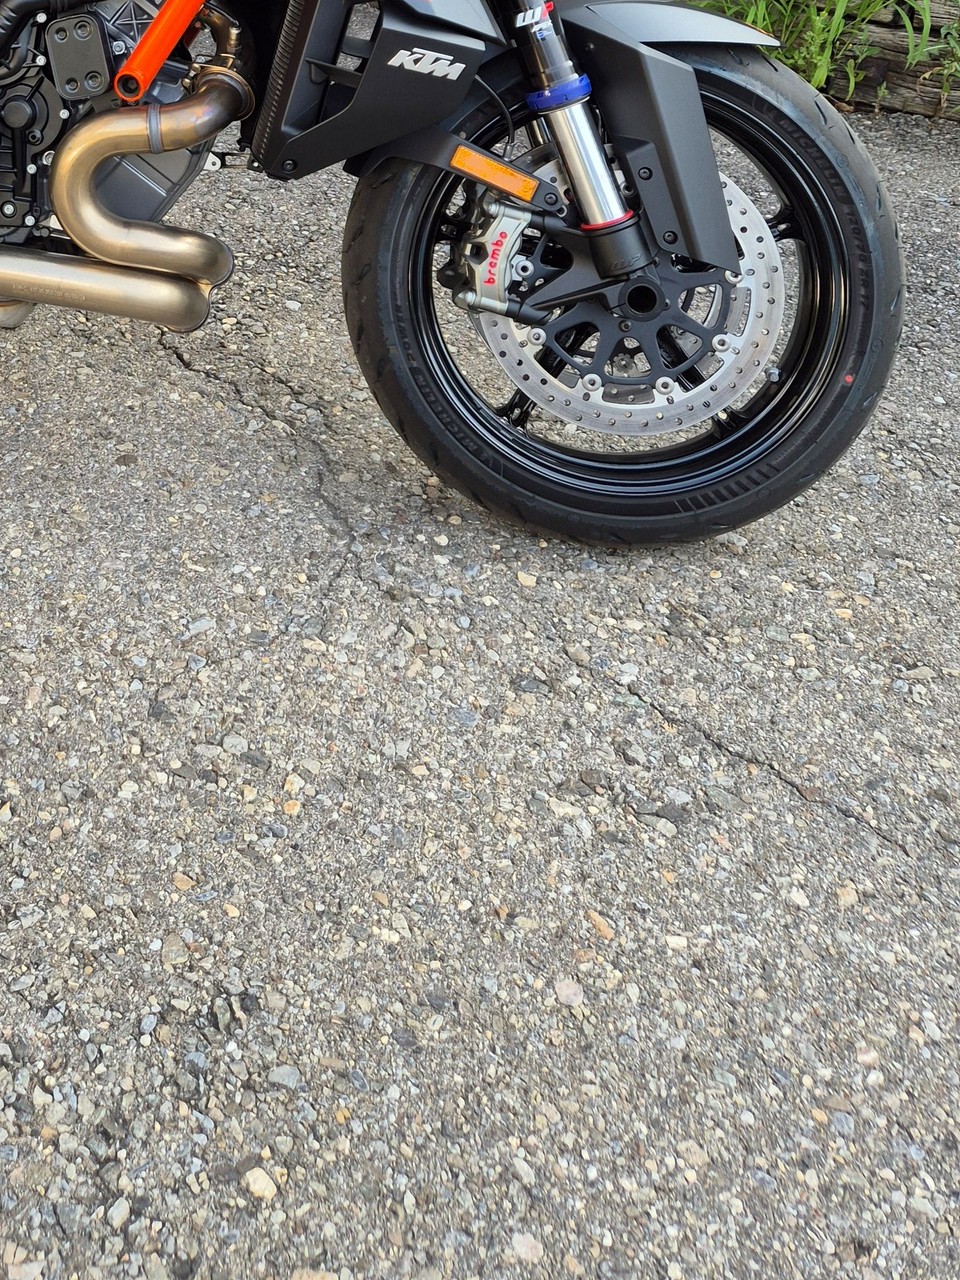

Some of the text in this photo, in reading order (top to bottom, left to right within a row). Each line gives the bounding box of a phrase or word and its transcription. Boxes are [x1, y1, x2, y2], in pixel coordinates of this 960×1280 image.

[387, 47, 467, 81] KTM
[779, 119, 847, 205] MICHELIN
[483, 231, 509, 286] brembo
[415, 373, 478, 454] MICHELIN
